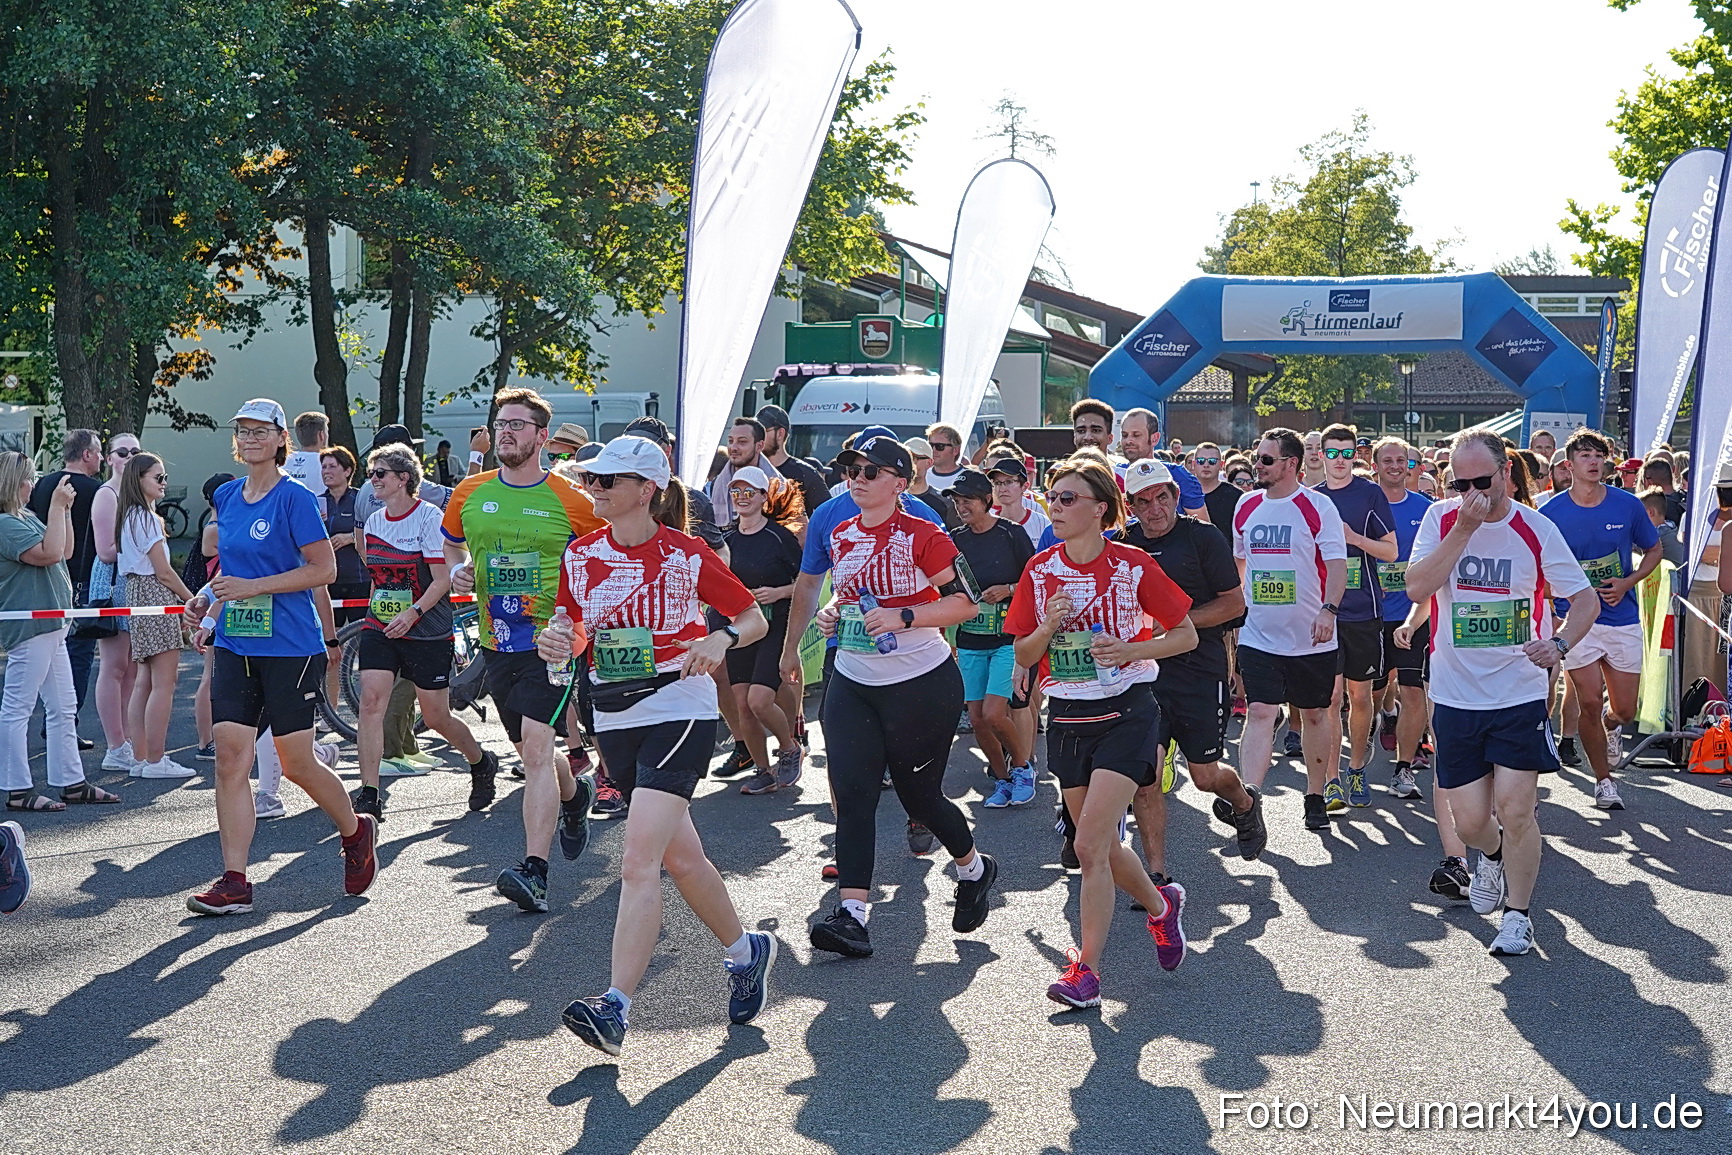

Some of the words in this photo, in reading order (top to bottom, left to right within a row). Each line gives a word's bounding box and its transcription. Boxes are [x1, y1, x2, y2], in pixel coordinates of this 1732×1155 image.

[1674, 175, 1719, 278] Fischer
[1314, 312, 1404, 329] firmenlauf
[1143, 334, 1191, 352] Fischer
[799, 402, 839, 413] abavent
[1249, 524, 1292, 545] OM
[498, 568, 527, 582] 599
[1458, 555, 1512, 582] OM
[1590, 565, 1613, 579] 456
[1260, 581, 1284, 594] 509
[379, 601, 402, 613] 963
[231, 608, 264, 623] 1746
[1468, 617, 1501, 633] 500
[597, 646, 643, 665] 1122
[643, 648, 654, 673] 2022
[1053, 647, 1095, 666] 1118
[621, 663, 645, 672] Bettina
